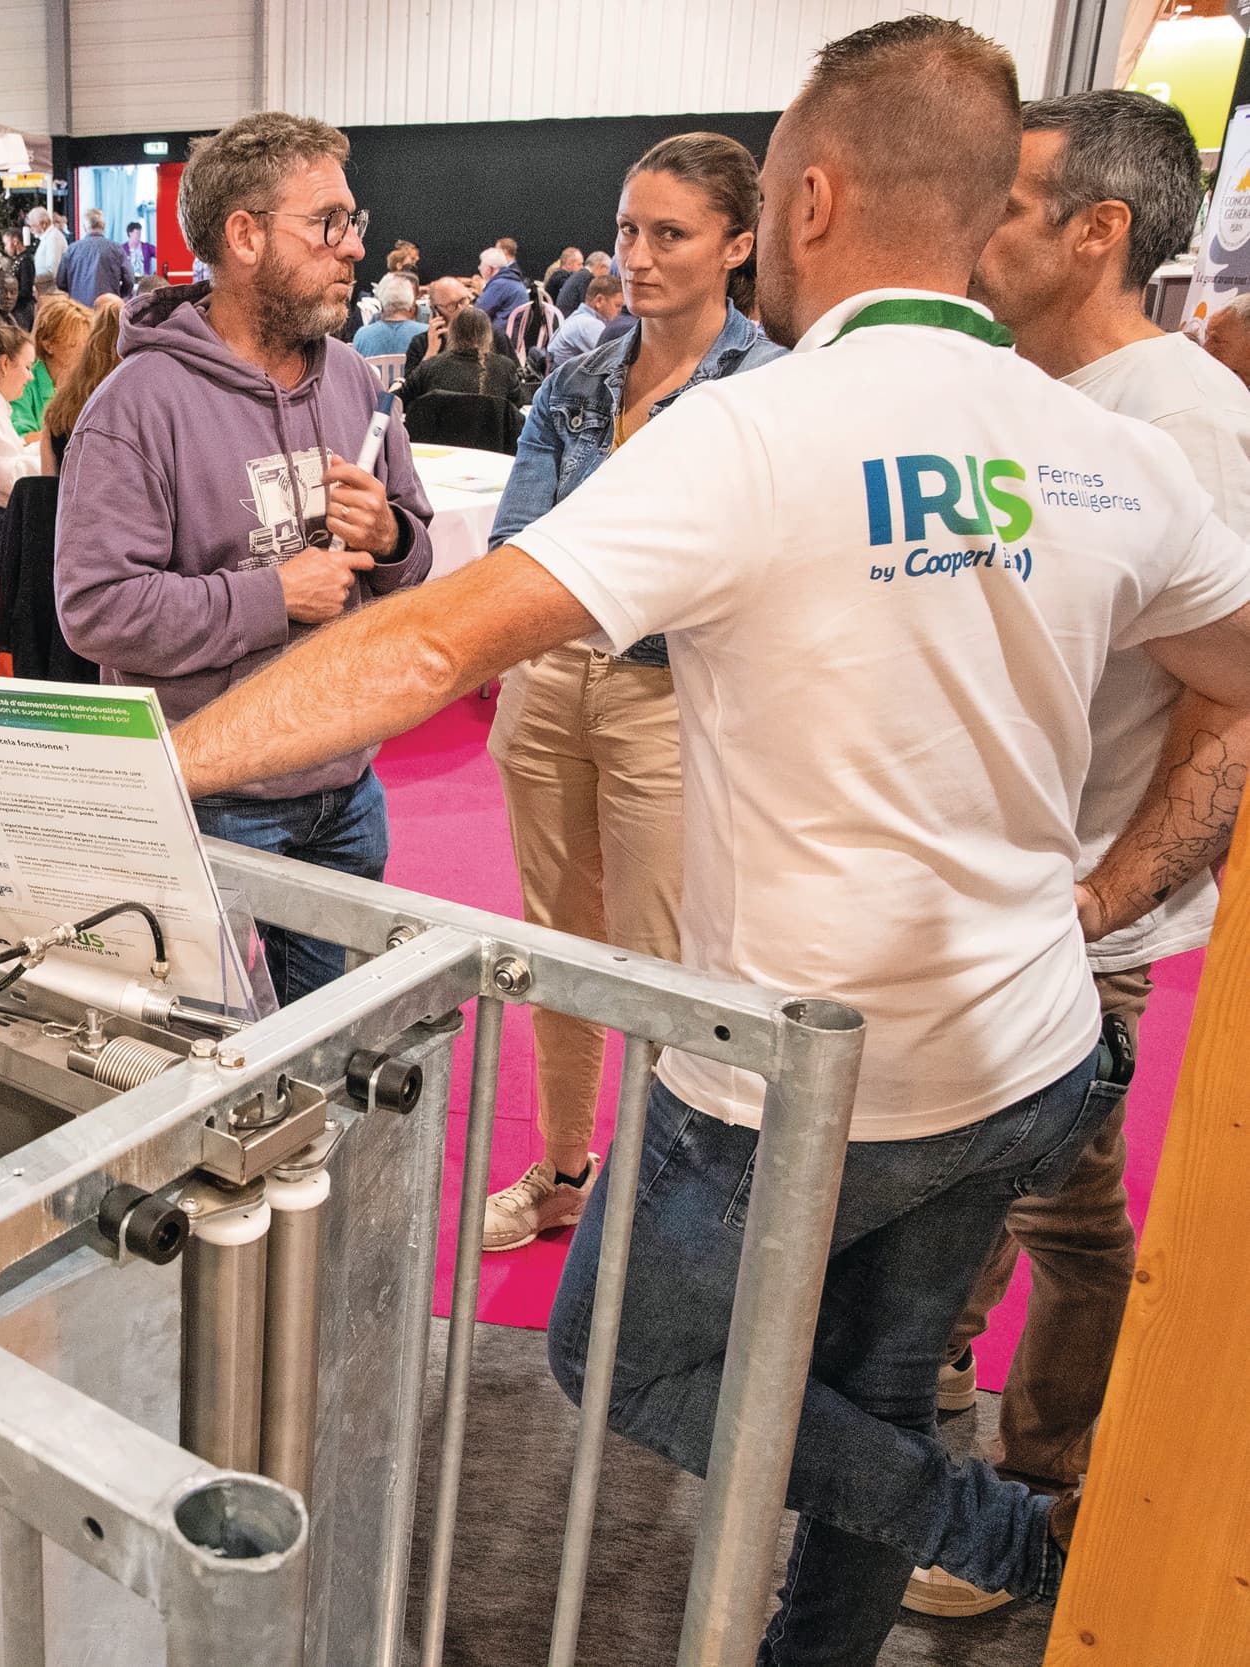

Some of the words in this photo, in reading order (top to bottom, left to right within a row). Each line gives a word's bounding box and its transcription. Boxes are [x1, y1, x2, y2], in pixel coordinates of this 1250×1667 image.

[862, 454, 1033, 546] IRIS
[1038, 465, 1104, 488] Fermes
[870, 565, 895, 582] by
[905, 542, 996, 578] Cooperl
[0, 737, 16, 746] cela
[17, 739, 63, 750] fonctionne
